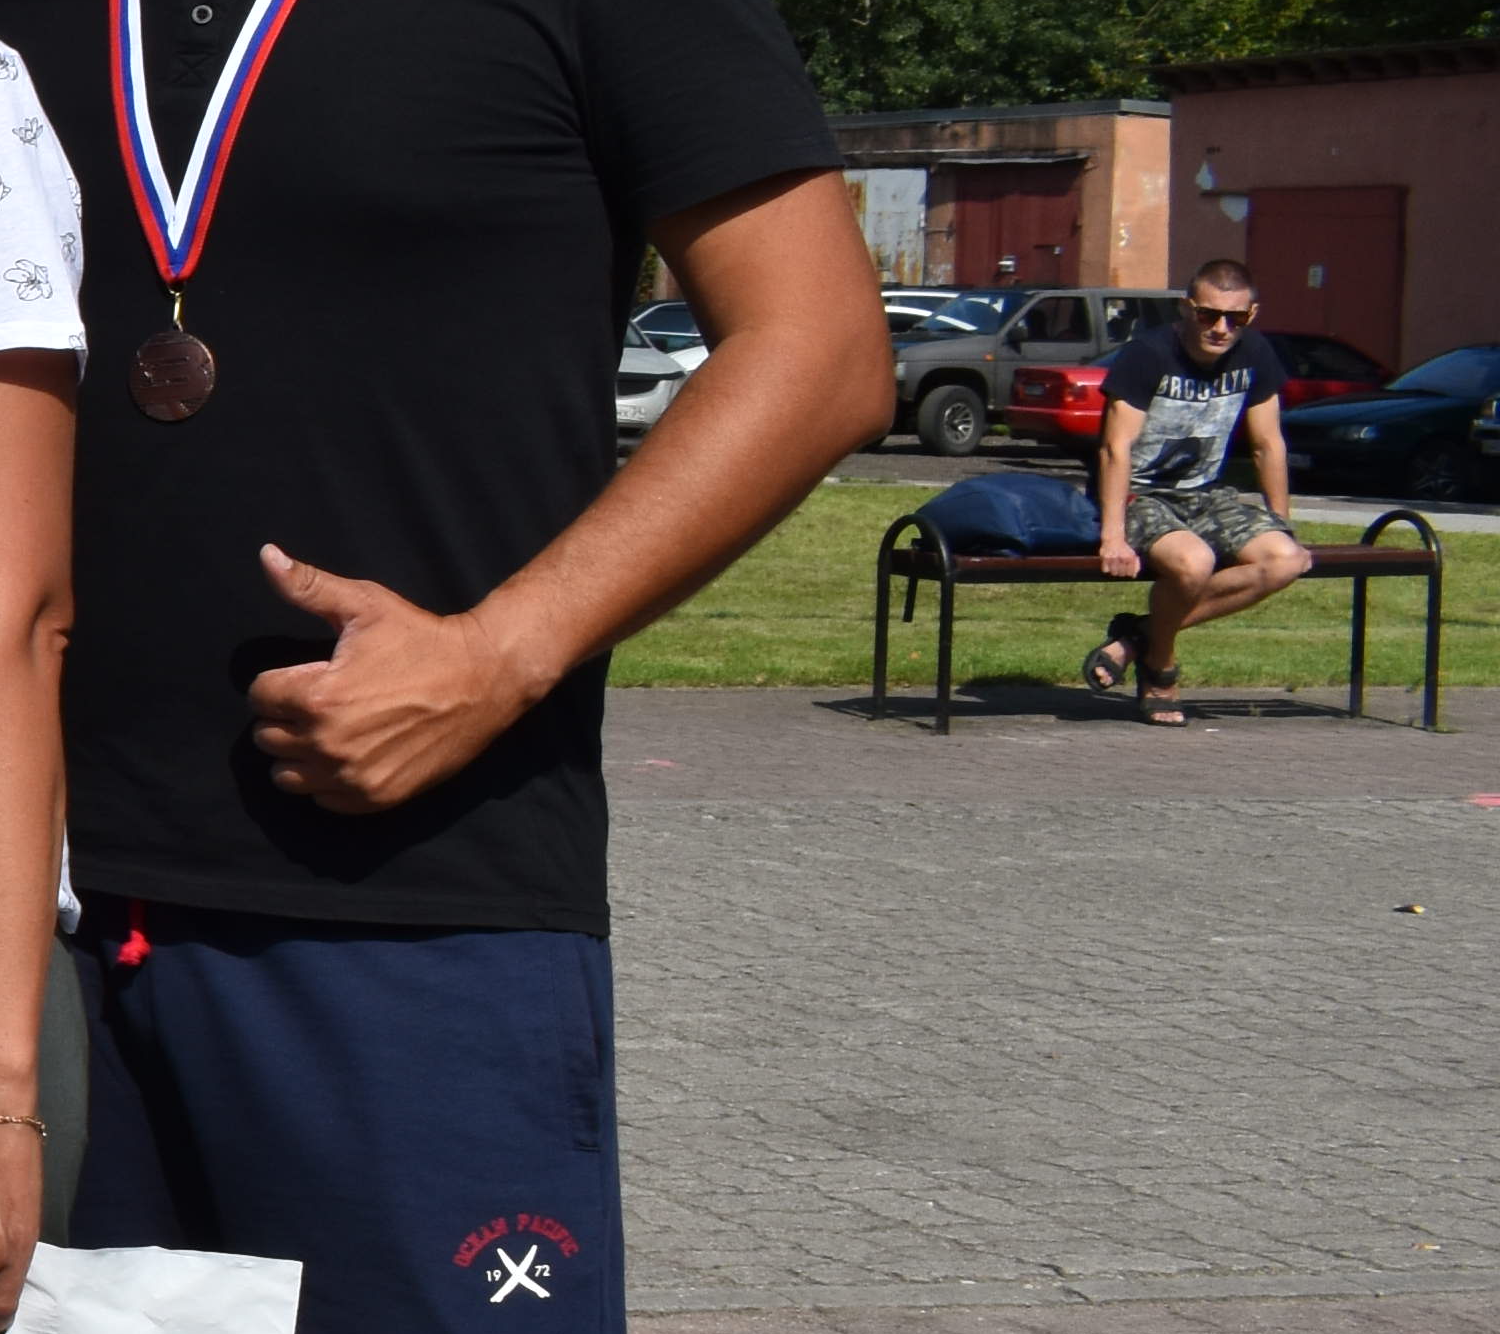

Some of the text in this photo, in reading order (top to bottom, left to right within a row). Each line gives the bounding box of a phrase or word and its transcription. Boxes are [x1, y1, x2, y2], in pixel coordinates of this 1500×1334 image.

[452, 1214, 579, 1268] OCEAN PACIFIC
[486, 1265, 550, 1282] 19 72
